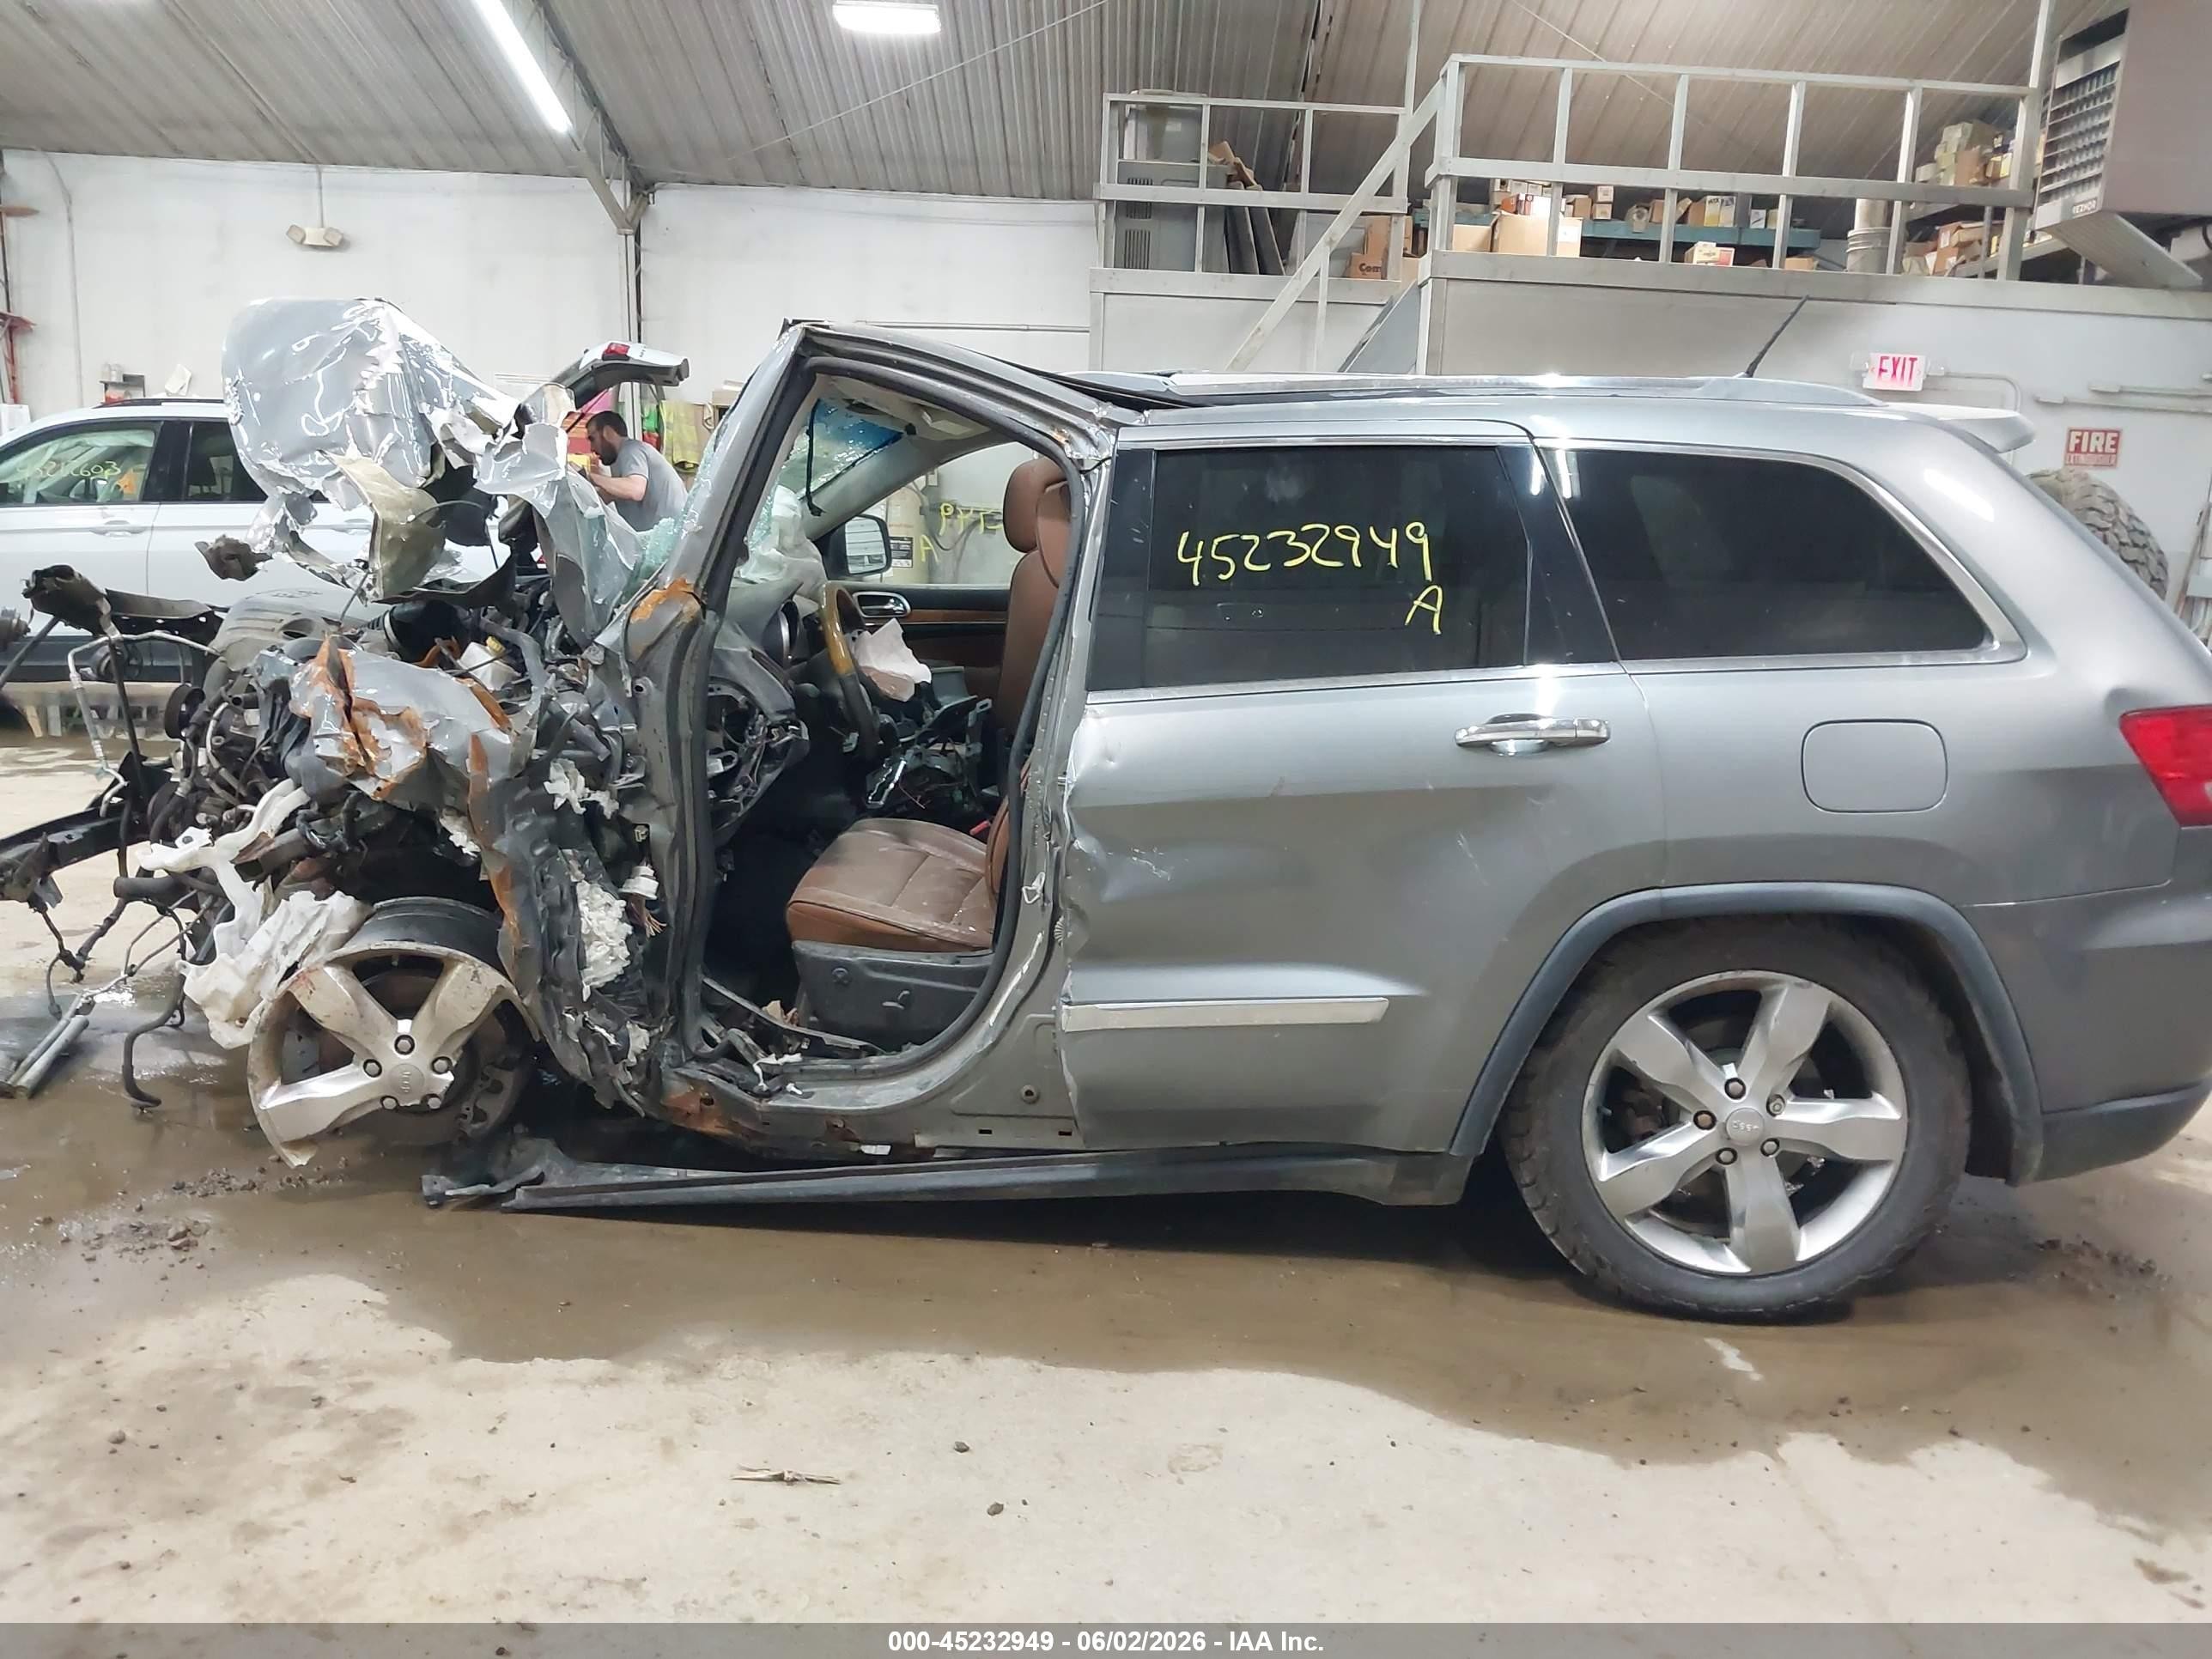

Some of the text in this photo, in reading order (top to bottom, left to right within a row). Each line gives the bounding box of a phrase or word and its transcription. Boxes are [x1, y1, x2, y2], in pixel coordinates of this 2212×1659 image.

[1877, 356, 1918, 386] EXIT
[2069, 431, 2118, 453] FIRE
[1176, 521, 1433, 586] 45232949
[1405, 585, 1443, 635] A
